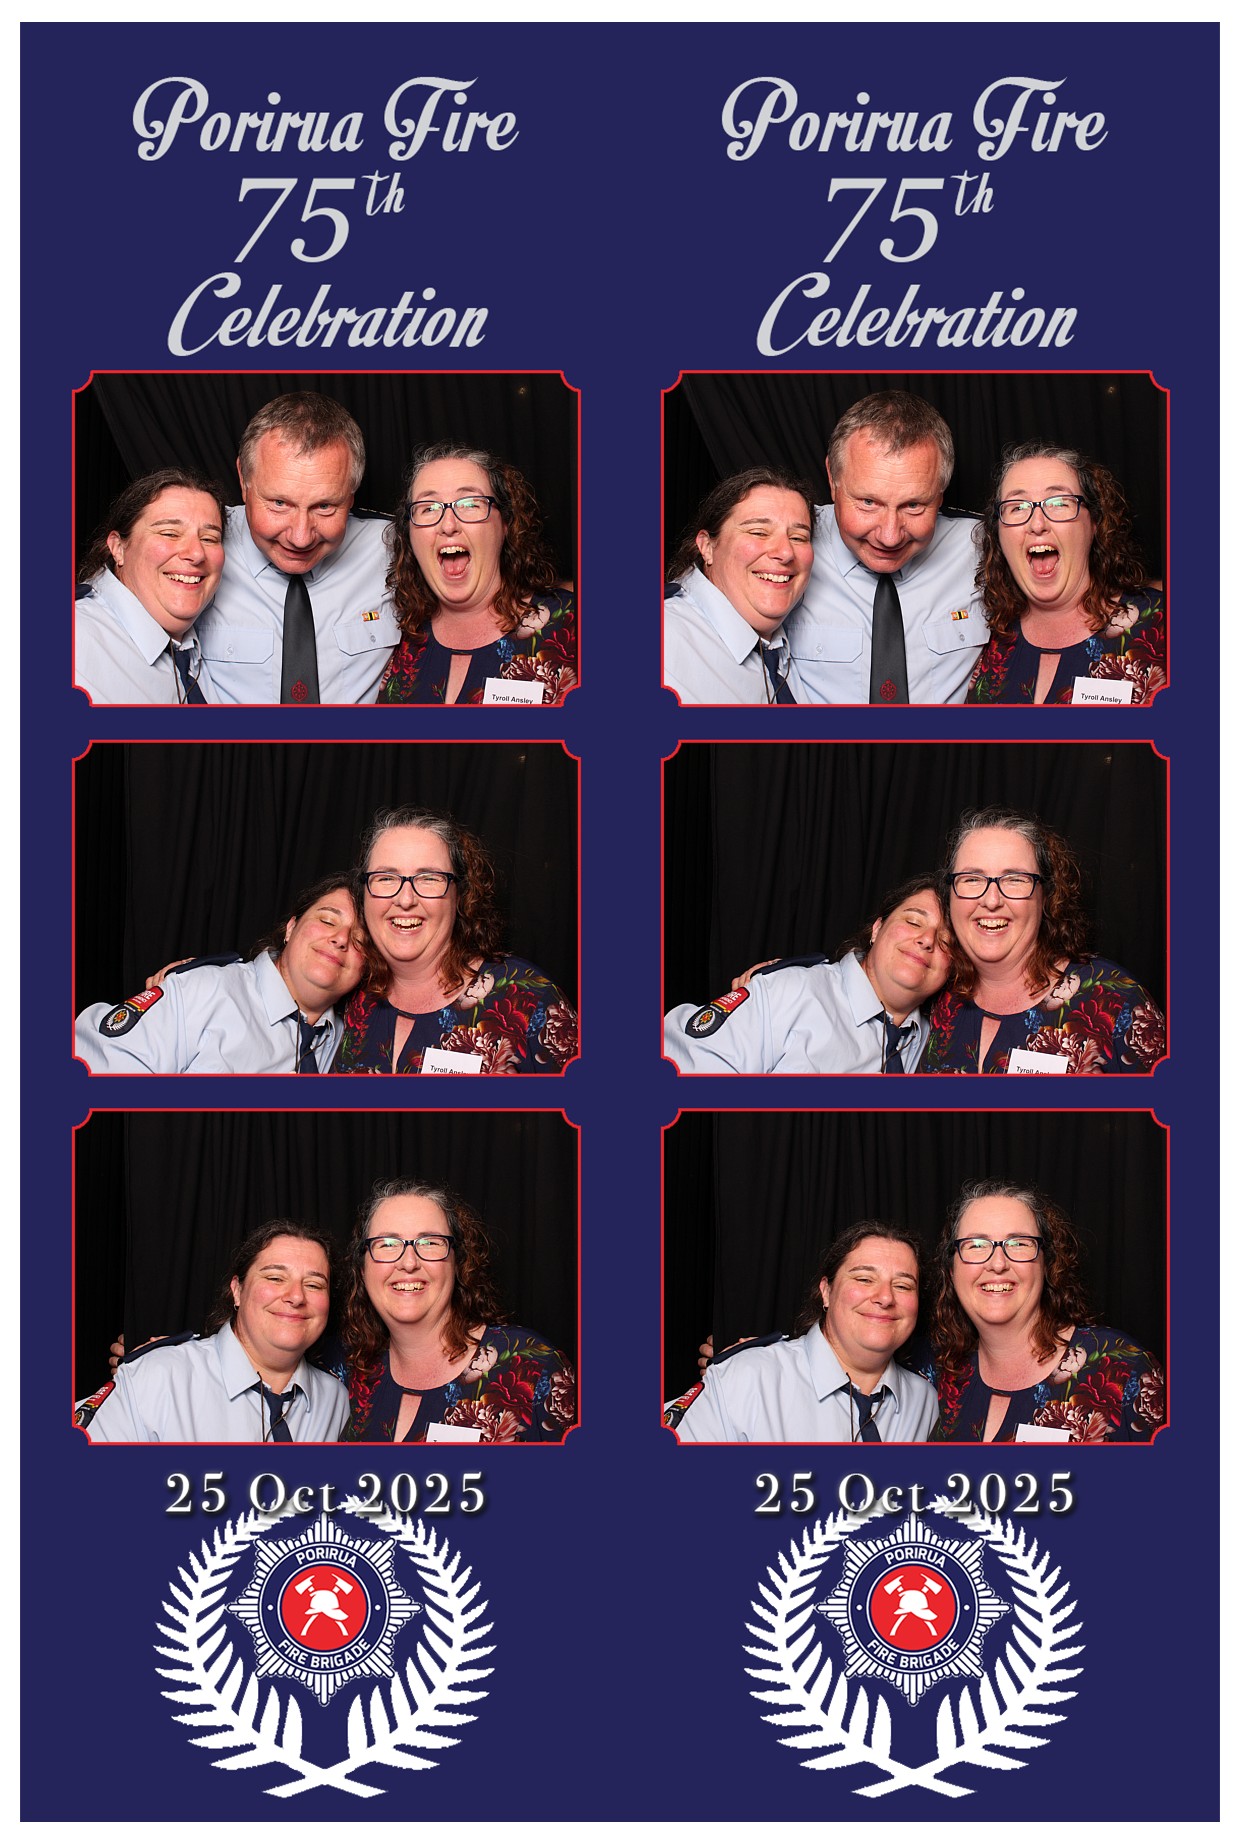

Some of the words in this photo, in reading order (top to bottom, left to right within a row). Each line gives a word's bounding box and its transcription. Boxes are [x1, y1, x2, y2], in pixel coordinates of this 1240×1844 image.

[492, 694, 510, 702] Tyroll
[511, 696, 533, 704] Ansley
[1081, 693, 1099, 701] Tyroll
[1100, 695, 1123, 704] Ansley
[430, 1065, 448, 1073] Tyroll
[1016, 1066, 1034, 1074] Tyroll
